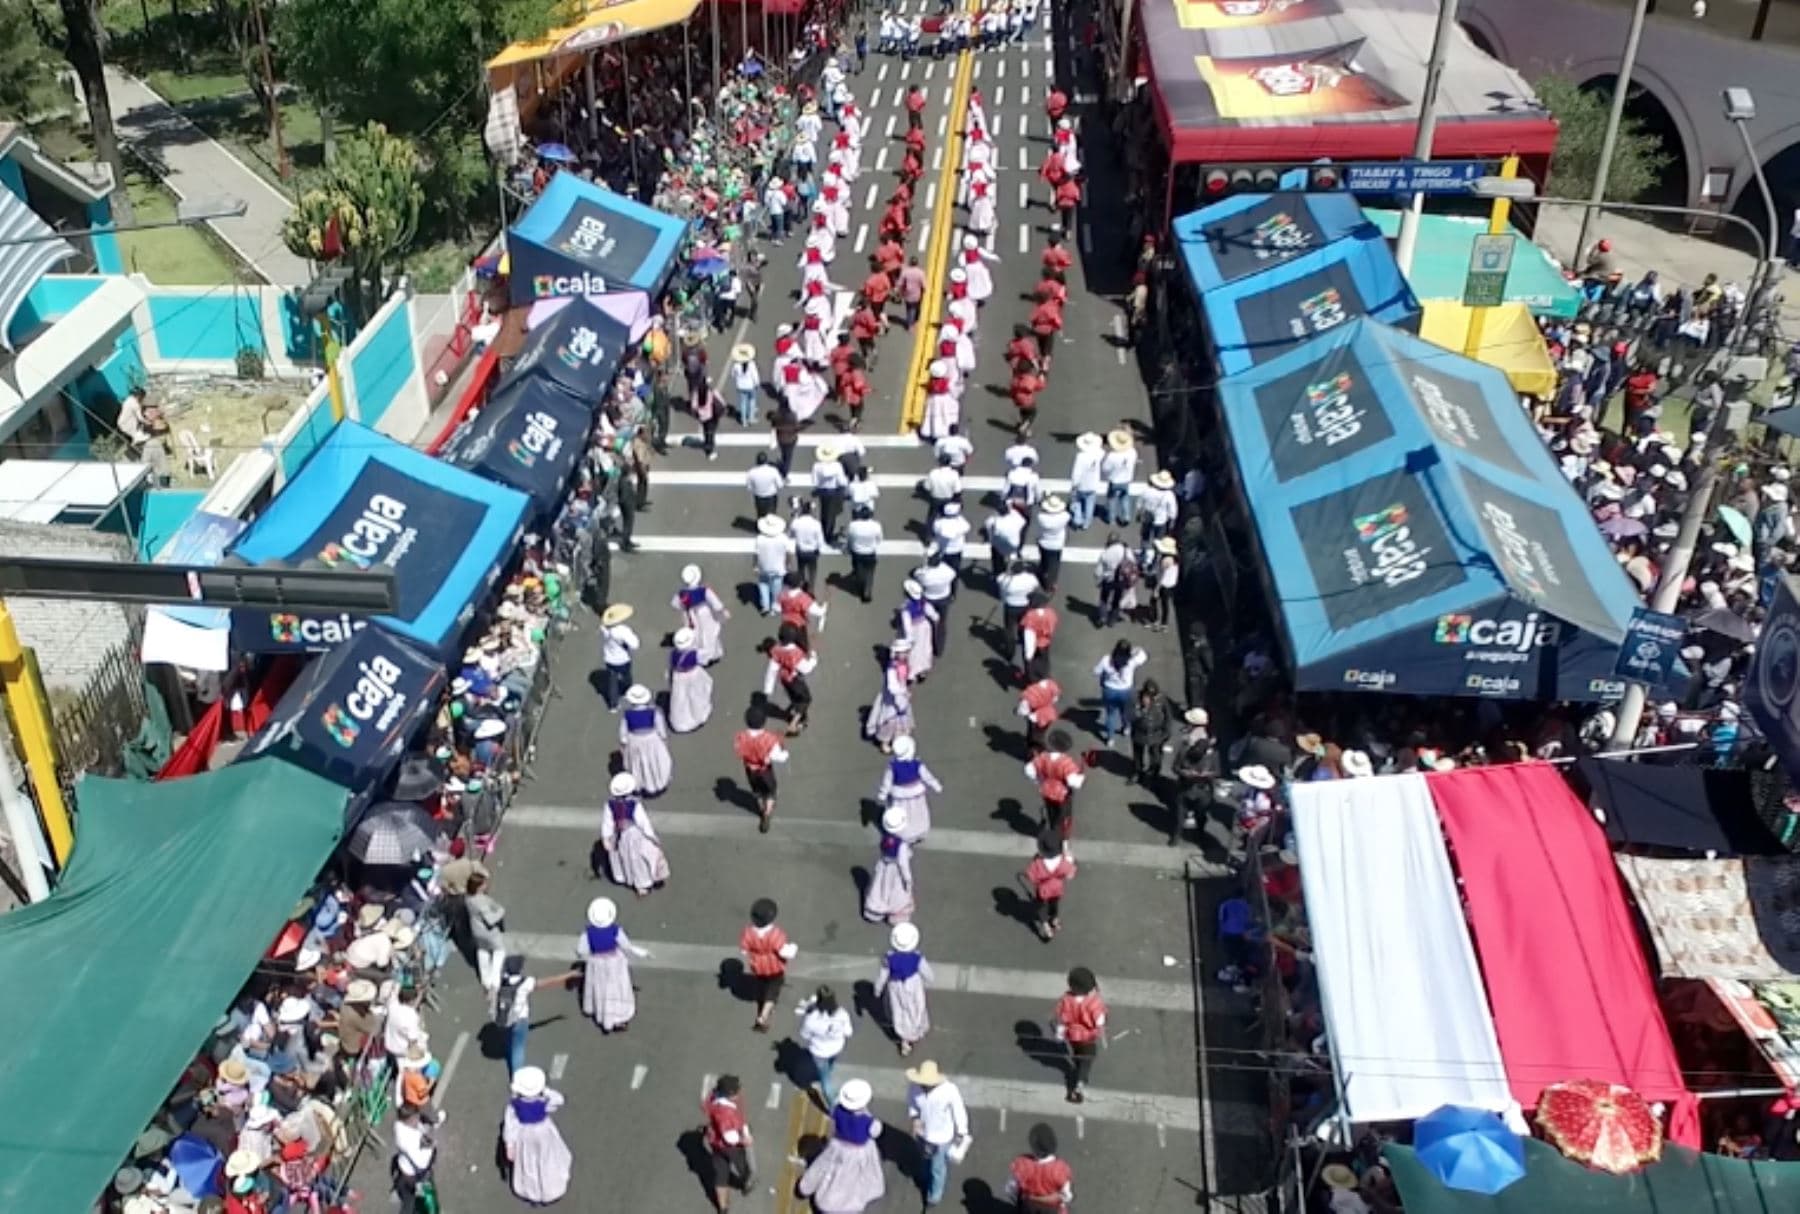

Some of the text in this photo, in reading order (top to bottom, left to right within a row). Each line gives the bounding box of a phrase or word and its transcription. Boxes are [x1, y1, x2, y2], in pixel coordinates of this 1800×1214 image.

[554, 271, 607, 300] caja
[521, 411, 558, 453] caja
[1314, 393, 1368, 447] caja
[341, 493, 407, 557] caja
[1371, 525, 1433, 589] caja
[301, 613, 368, 642] caj
[1469, 612, 1560, 652] caja
[346, 655, 402, 719] caja
